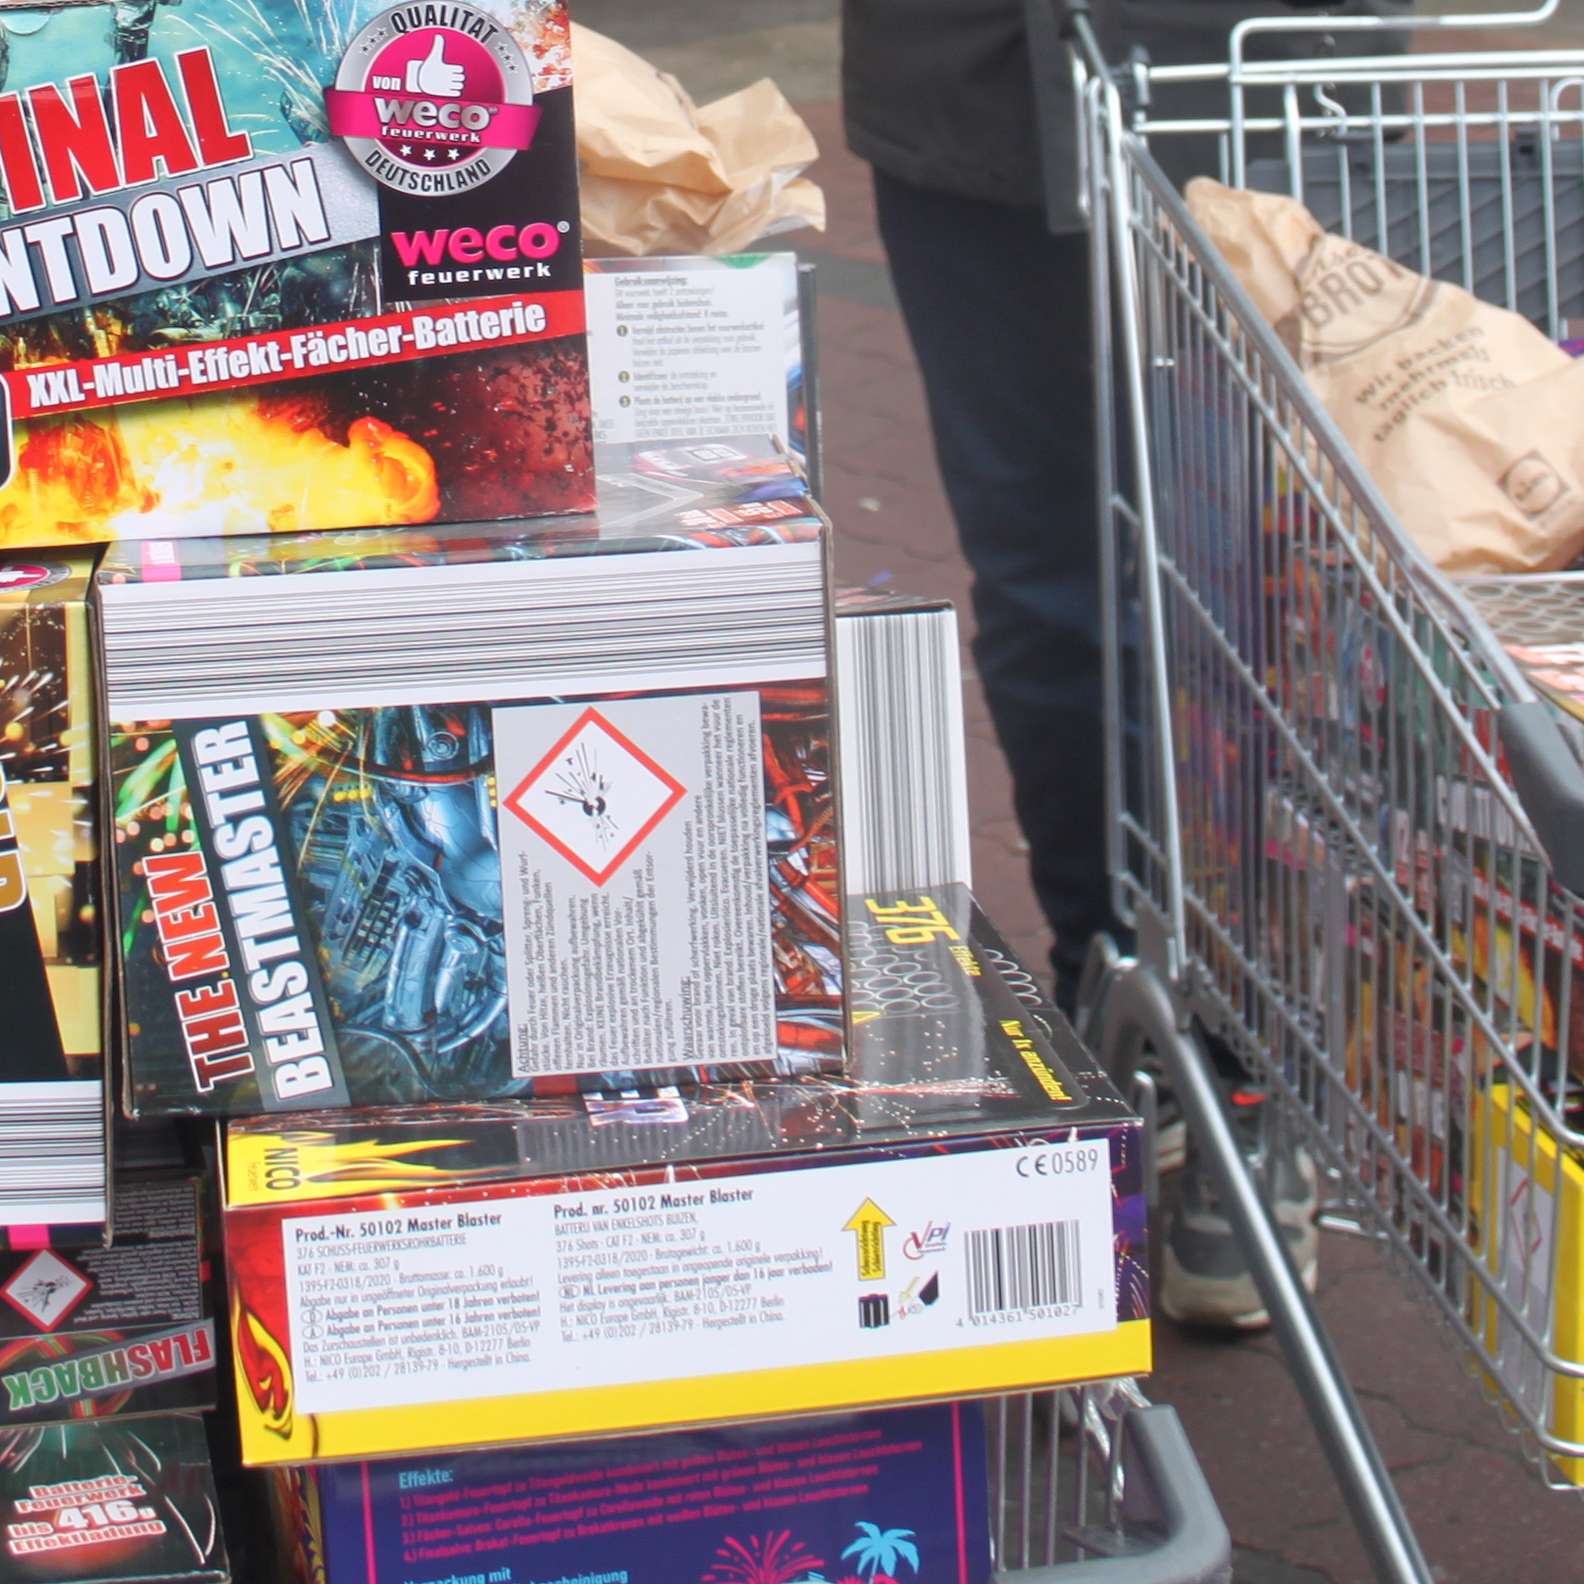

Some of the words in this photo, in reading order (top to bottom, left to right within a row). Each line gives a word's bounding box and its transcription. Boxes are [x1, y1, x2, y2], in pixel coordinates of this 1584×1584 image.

[372, 76, 401, 91] von
[381, 125, 481, 143] feuerwerk
[364, 149, 492, 192] DEUTSCHLAND
[407, 261, 551, 287] feuerwerk
[25, 298, 548, 411] XXL-Multi-Effekt-Fächer-Batterie
[1355, 372, 1394, 405] Wir
[141, 850, 230, 983] NEW
[193, 719, 334, 1102] BEASTMASTER
[864, 895, 960, 946] 376
[175, 973, 257, 1094] THE
[678, 976, 693, 1061] Waarschuwing:
[517, 1024, 529, 1073] Achtung:
[264, 1147, 301, 1190] NICO
[554, 1204, 587, 1219] Prod.
[592, 1203, 608, 1216] nr.
[614, 1196, 655, 1213] 50102
[660, 1191, 704, 1208] Master
[710, 1188, 754, 1204] Blaster
[295, 1226, 355, 1243] Prod.-Nr.
[359, 1221, 403, 1238] 50102
[407, 1217, 452, 1233] Master
[457, 1213, 502, 1229] Blaster
[377, 1303, 418, 1317] Personen
[2, 1328, 212, 1411] FLASHBACK
[29, 1475, 139, 1499] Batterie-
[399, 1469, 454, 1489] Effekte:
[14, 1484, 147, 1514] Feuerwerk
[8, 1521, 54, 1539] bis
[8, 1519, 167, 1555] Effektladung
[488, 1567, 512, 1583] mit
